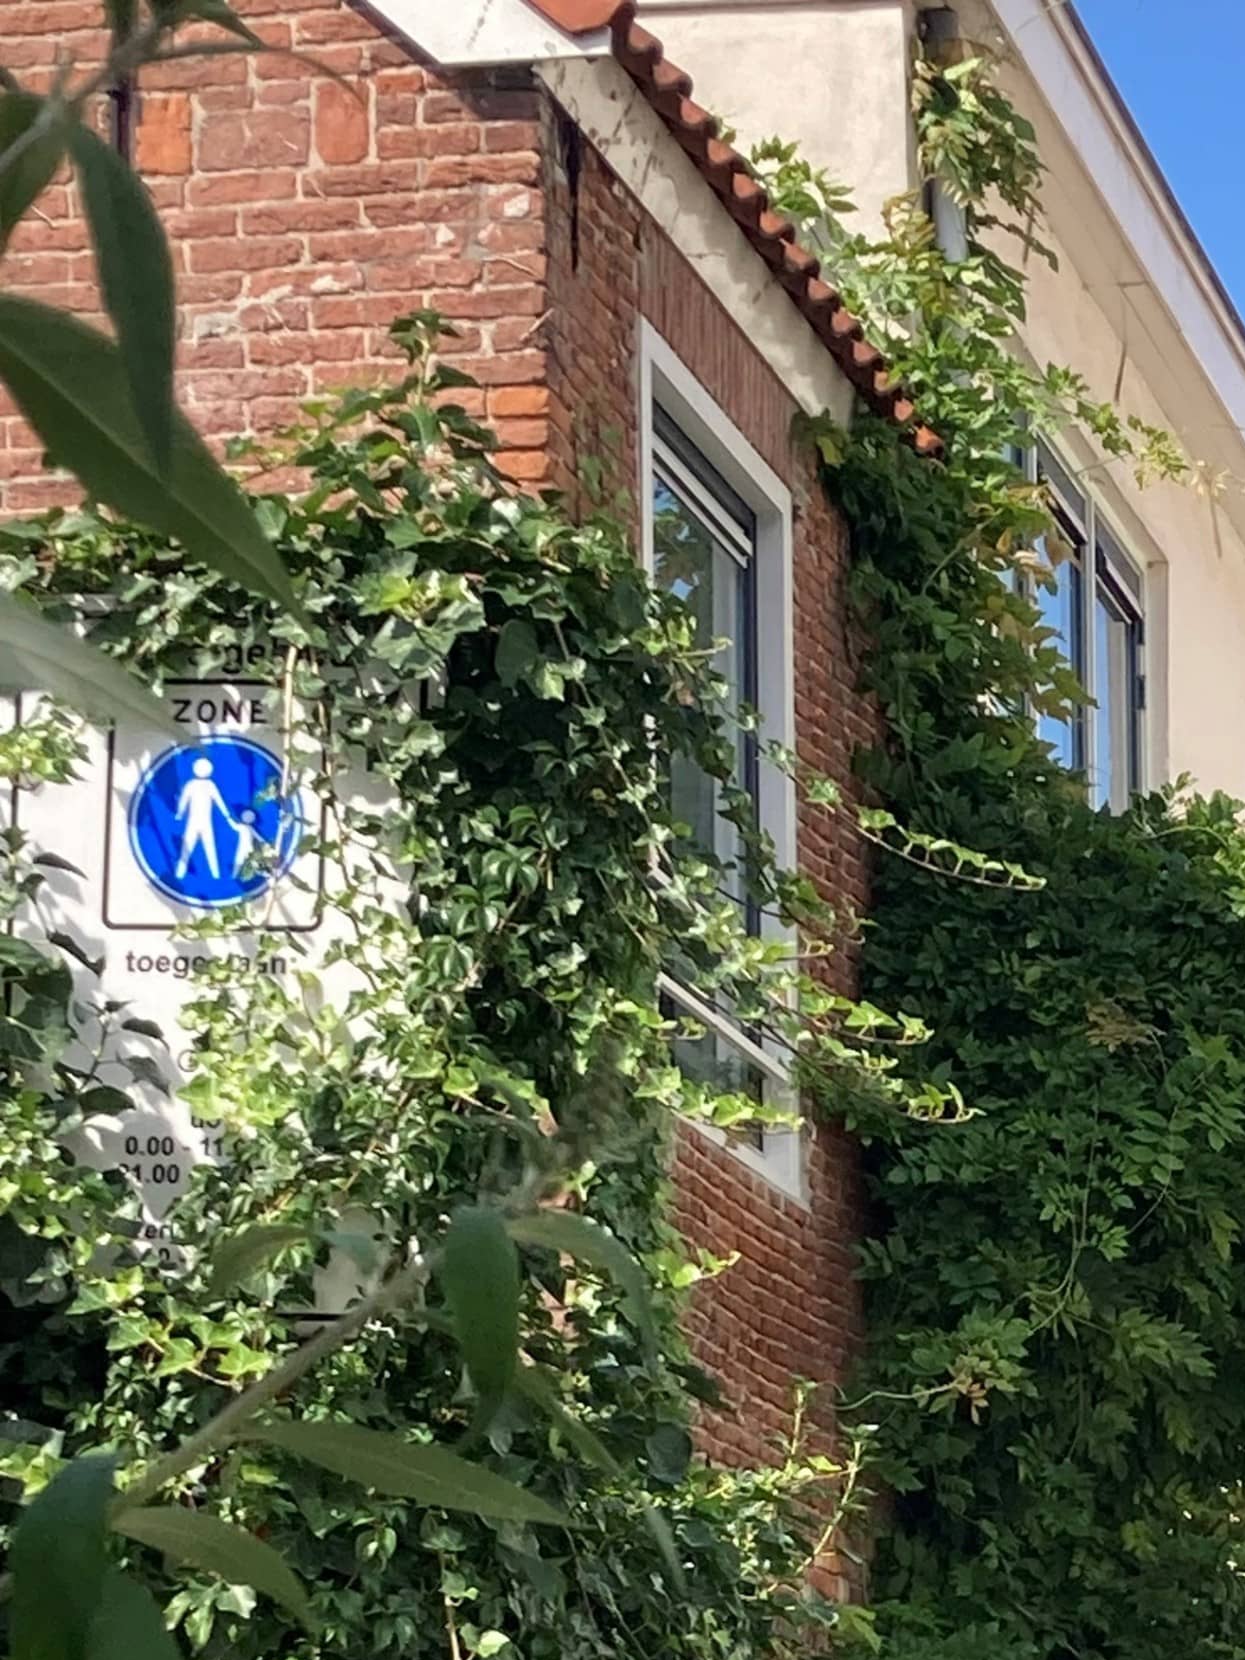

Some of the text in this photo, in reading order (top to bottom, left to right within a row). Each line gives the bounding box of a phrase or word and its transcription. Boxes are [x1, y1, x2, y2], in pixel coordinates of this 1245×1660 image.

[172, 699, 267, 724] ZONE
[125, 1136, 175, 1156] 0.00
[200, 1137, 245, 1157] 11.
